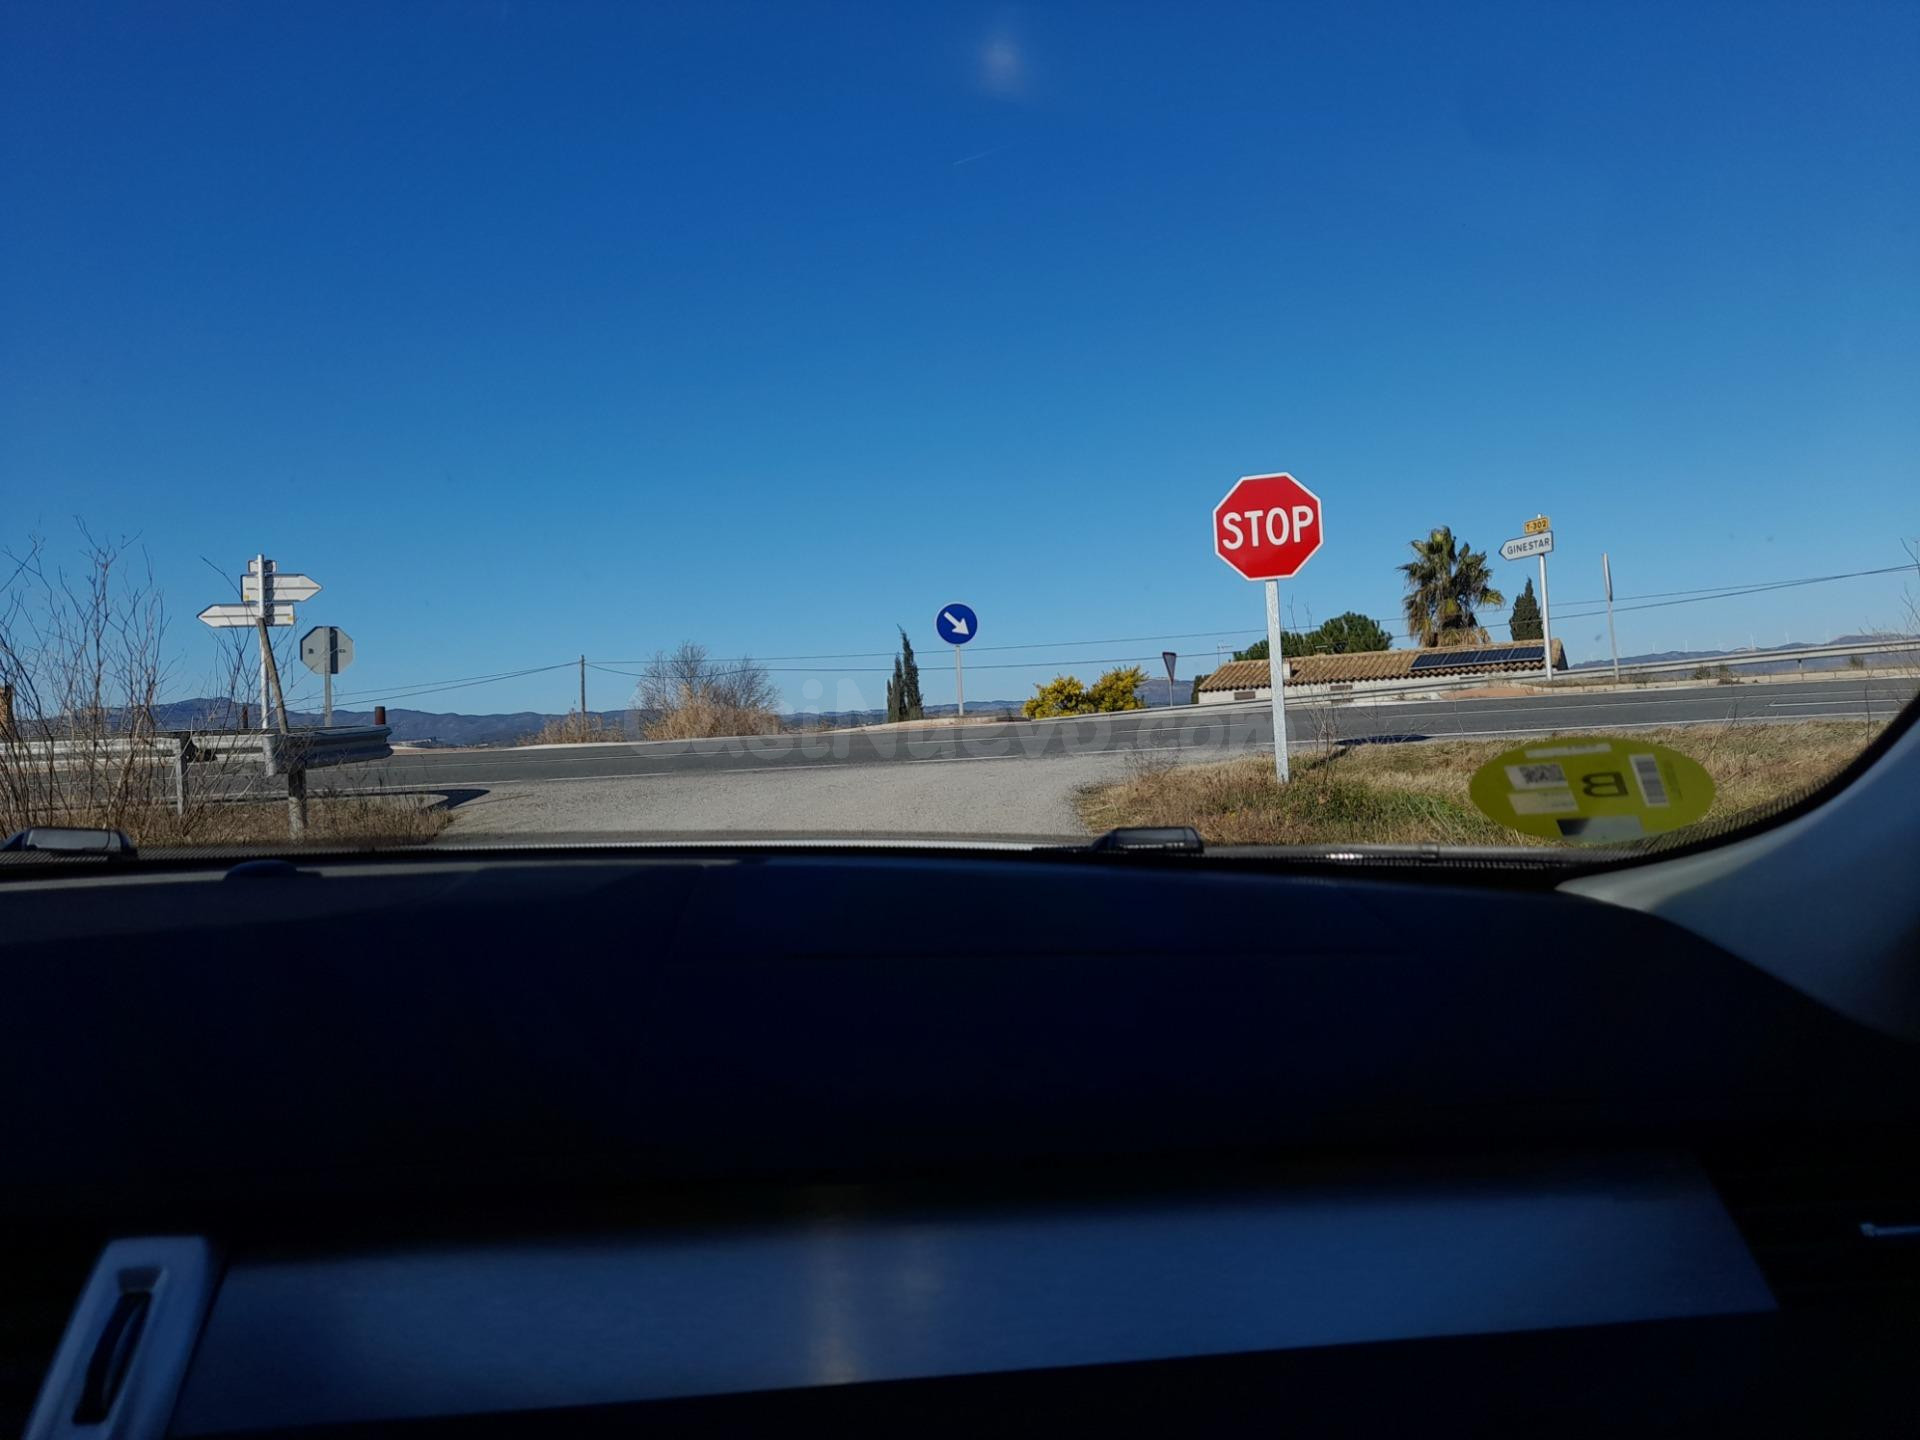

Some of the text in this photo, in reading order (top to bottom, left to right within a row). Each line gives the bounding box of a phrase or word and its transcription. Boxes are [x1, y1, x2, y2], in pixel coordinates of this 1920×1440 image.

[1222, 505, 1314, 550] STOP
[1526, 520, 1547, 531] T-302
[1507, 537, 1550, 555] GINESTAR
